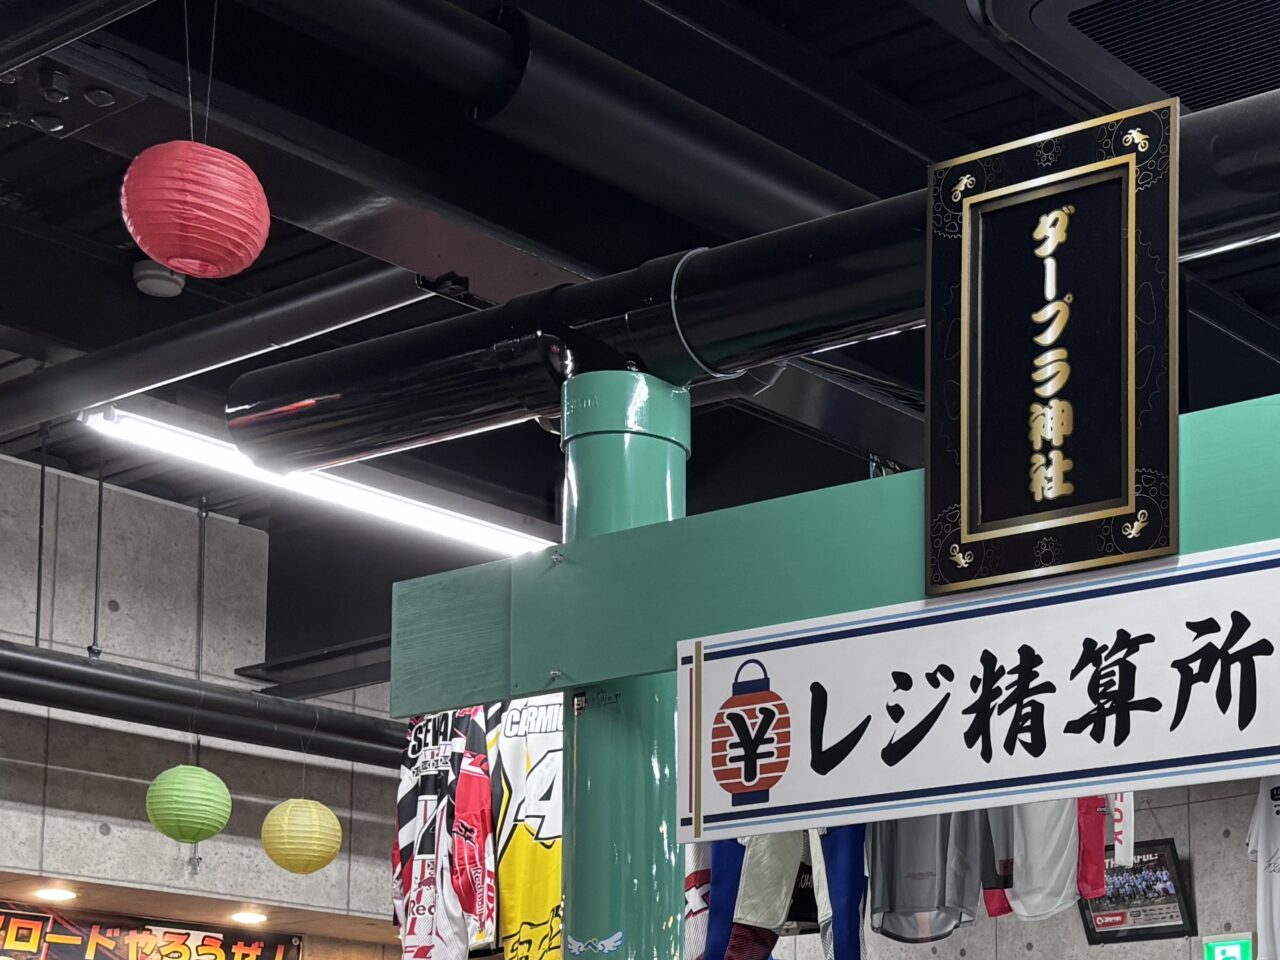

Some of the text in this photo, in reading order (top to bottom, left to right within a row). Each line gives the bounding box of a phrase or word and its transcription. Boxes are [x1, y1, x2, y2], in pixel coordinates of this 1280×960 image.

[1028, 205, 1075, 502] ダープラ神社
[809, 609, 1274, 776] レジ精算所
